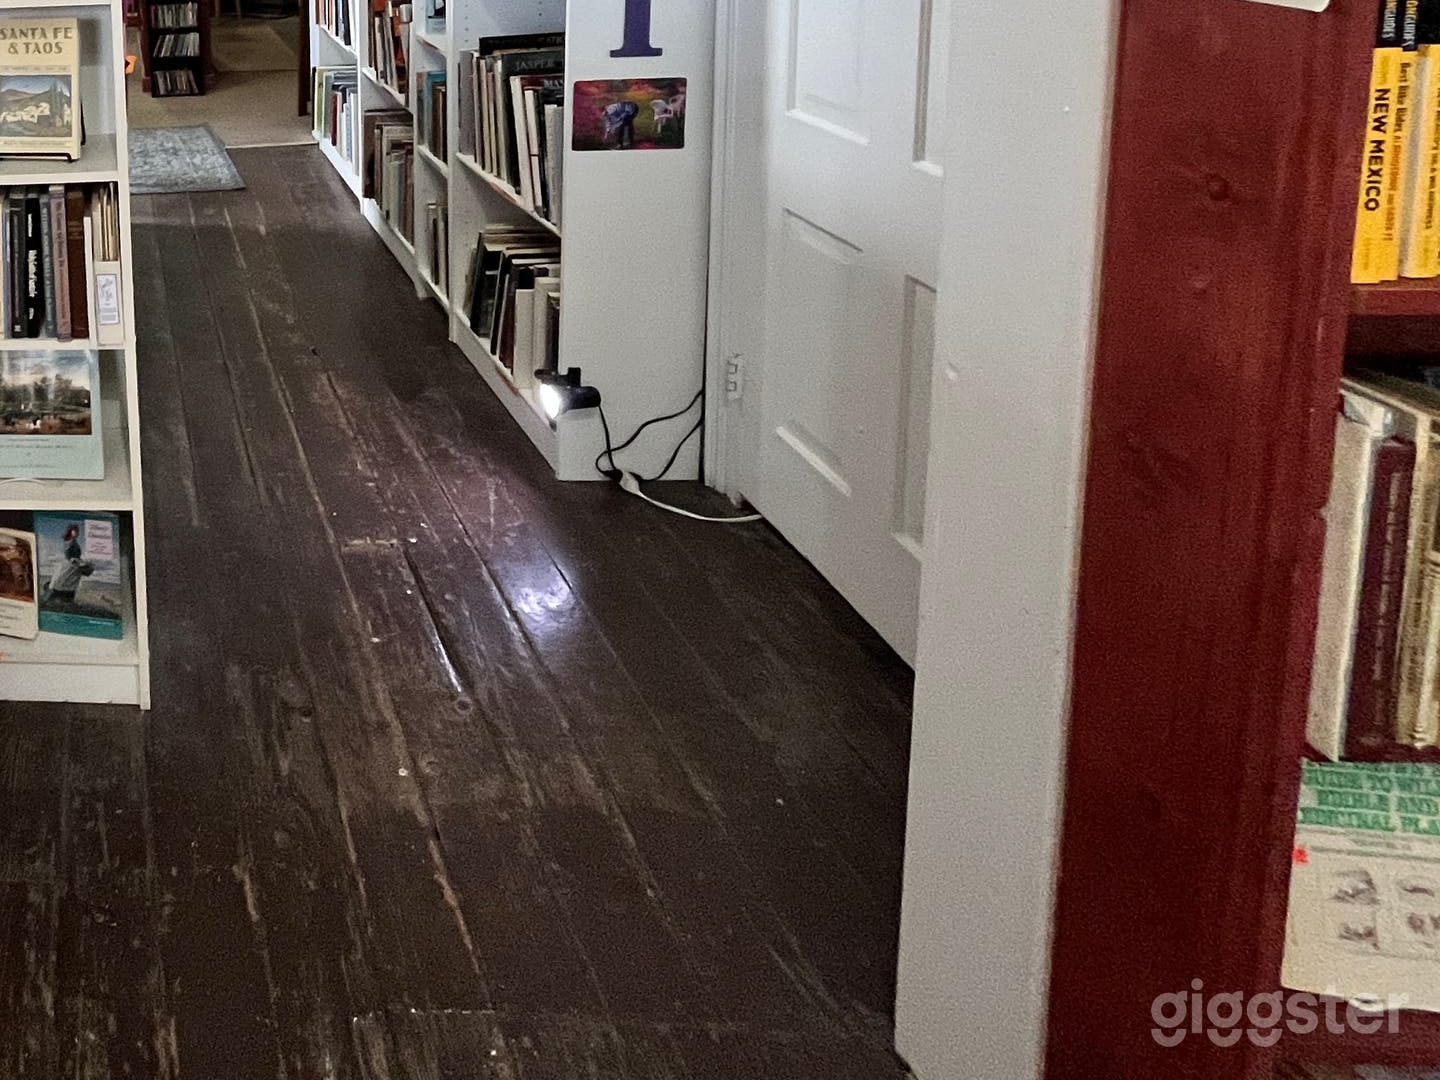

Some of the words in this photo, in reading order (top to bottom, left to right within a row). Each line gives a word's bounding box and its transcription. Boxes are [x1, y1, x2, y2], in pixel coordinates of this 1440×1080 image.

[0, 27, 48, 40] SANTA
[53, 27, 73, 39] FE
[8, 42, 19, 54] &
[23, 42, 63, 54] TAOS
[516, 62, 554, 70] JASPER
[1371, 88, 1392, 134] NEW
[1364, 139, 1386, 212] MEXICO
